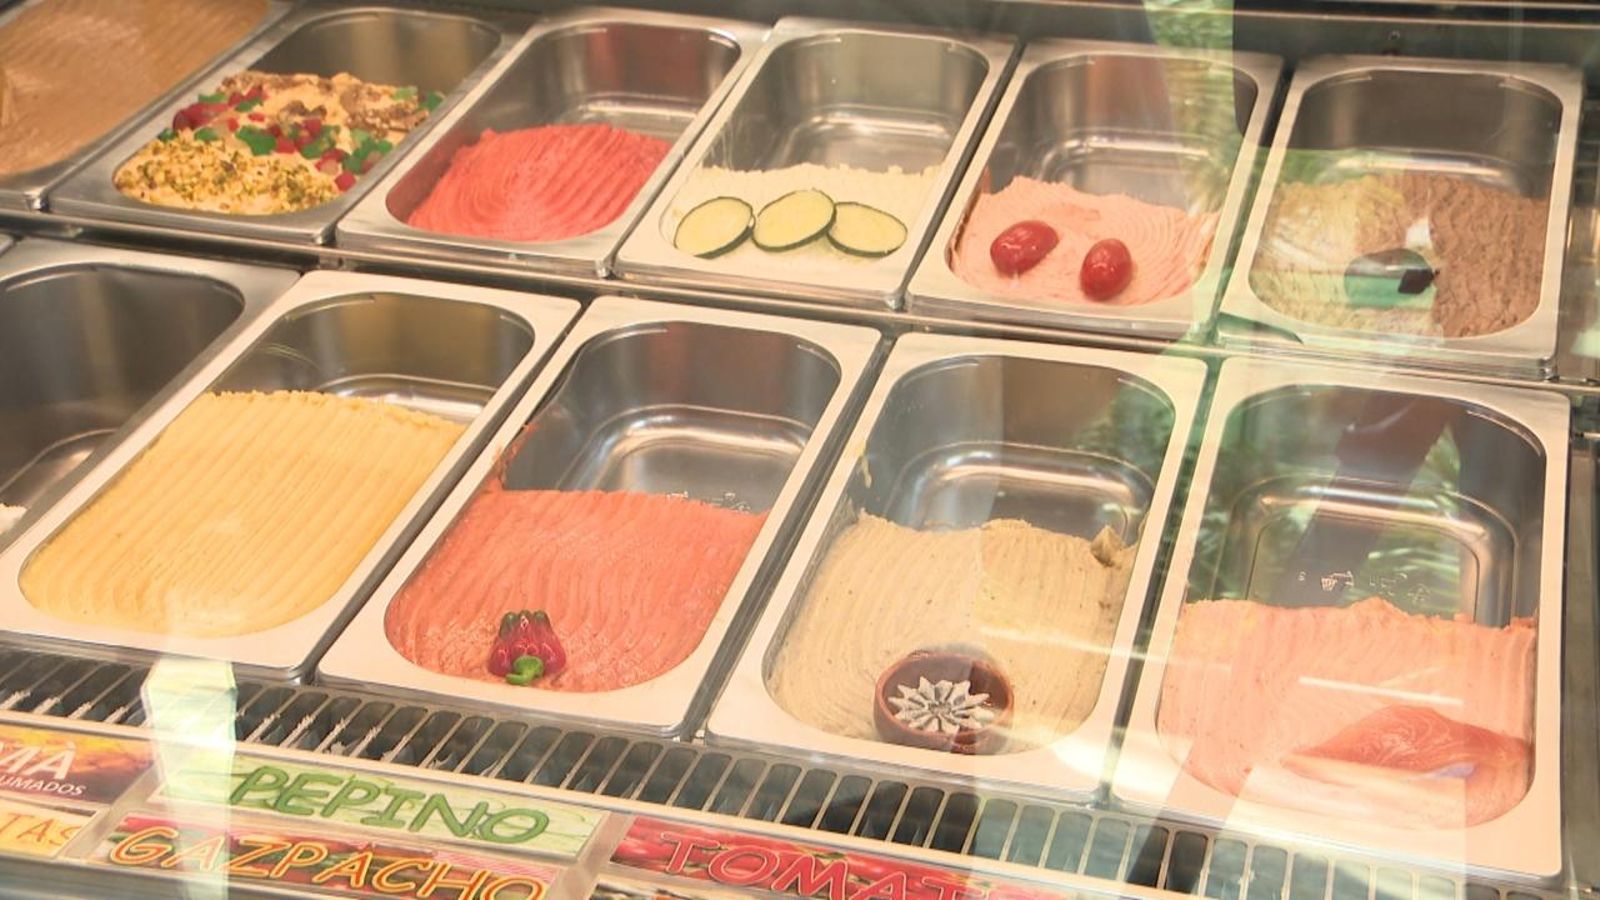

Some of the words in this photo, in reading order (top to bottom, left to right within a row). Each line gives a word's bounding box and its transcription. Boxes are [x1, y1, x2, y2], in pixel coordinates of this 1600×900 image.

[229, 765, 550, 844] PEPINO
[109, 825, 546, 900] GAZPACHO
[660, 831, 1030, 900] TOMAT
